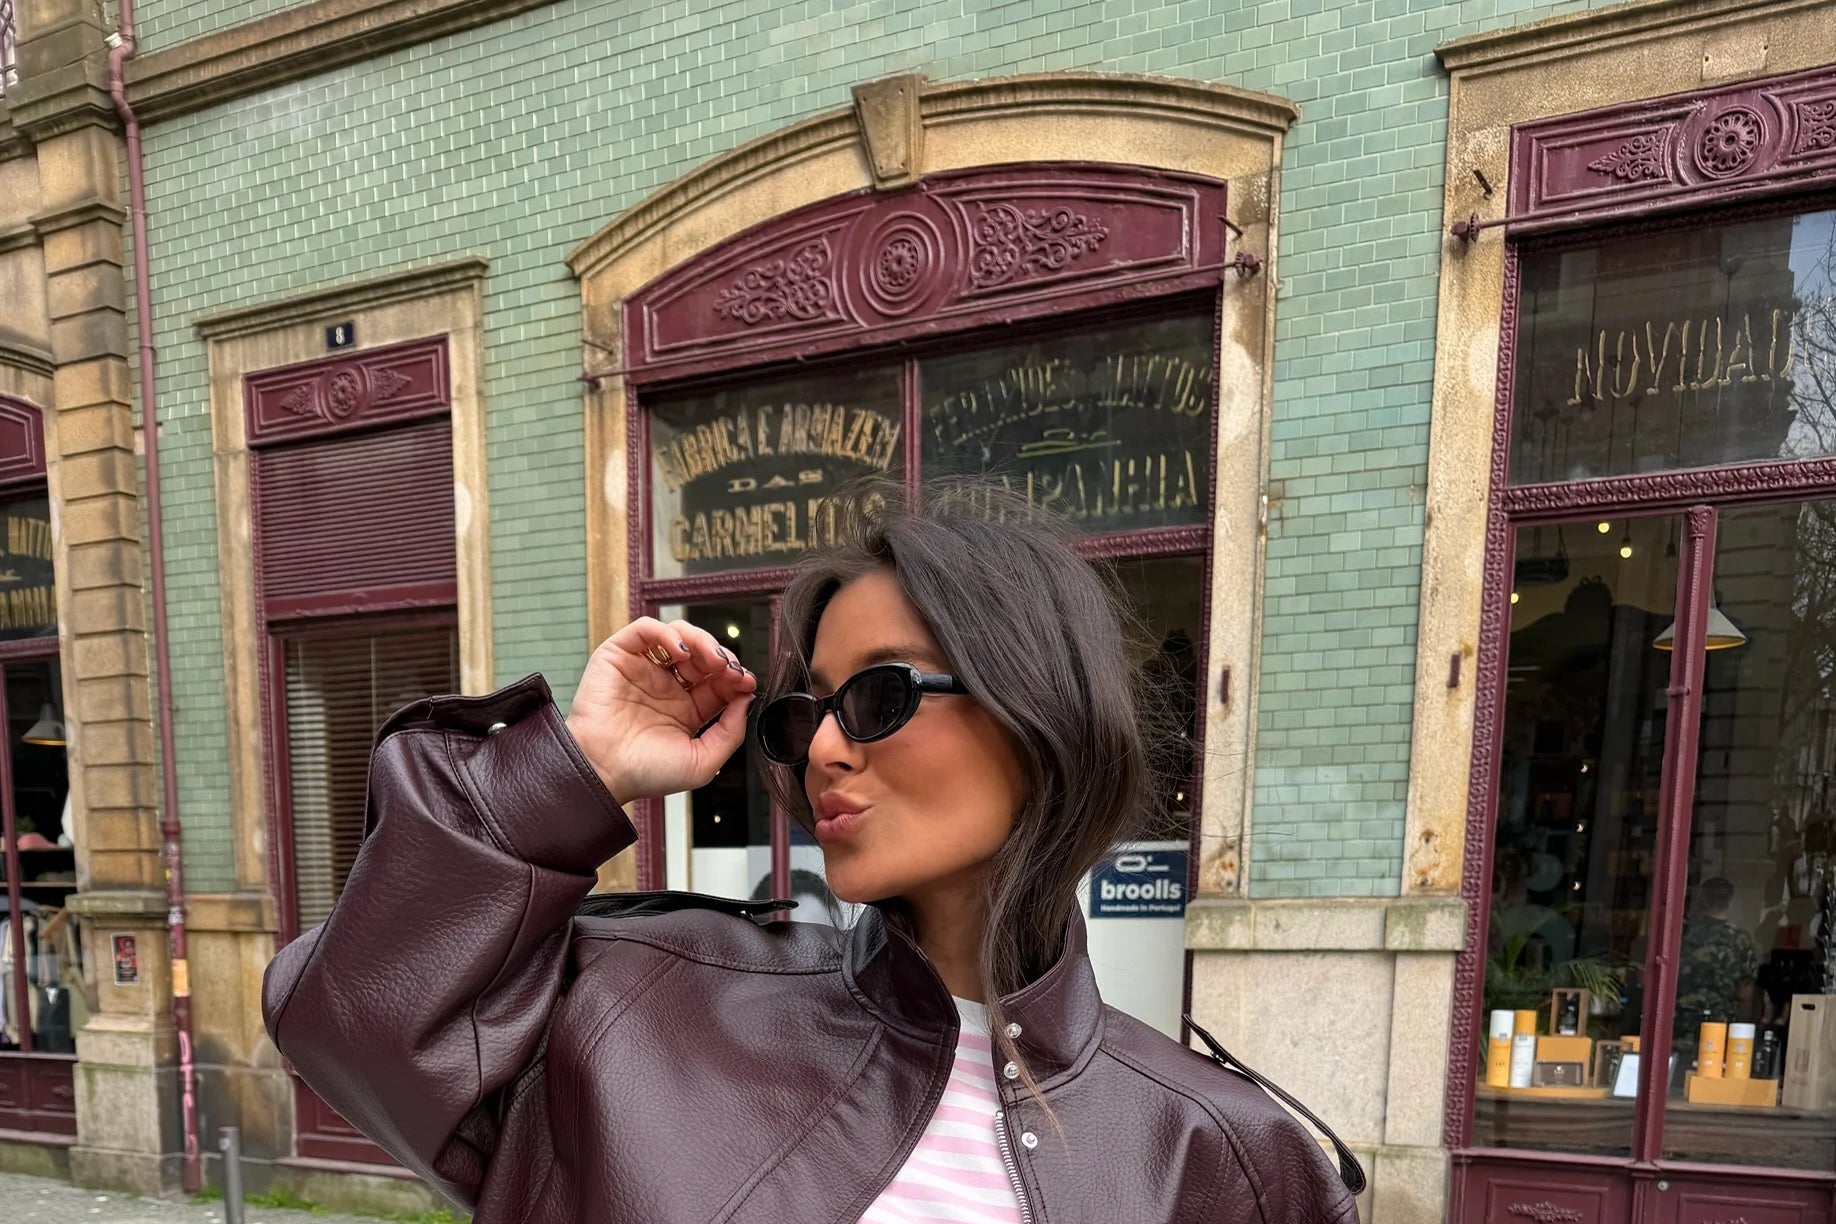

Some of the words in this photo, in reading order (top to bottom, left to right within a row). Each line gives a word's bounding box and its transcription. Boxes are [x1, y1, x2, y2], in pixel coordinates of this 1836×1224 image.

[335, 326, 345, 345] 8
[757, 405, 773, 455] E
[728, 469, 824, 493] DAS
[1101, 879, 1181, 900] broolls
[1100, 904, 1139, 912] Handmade
[1148, 904, 1180, 913] Portugal
